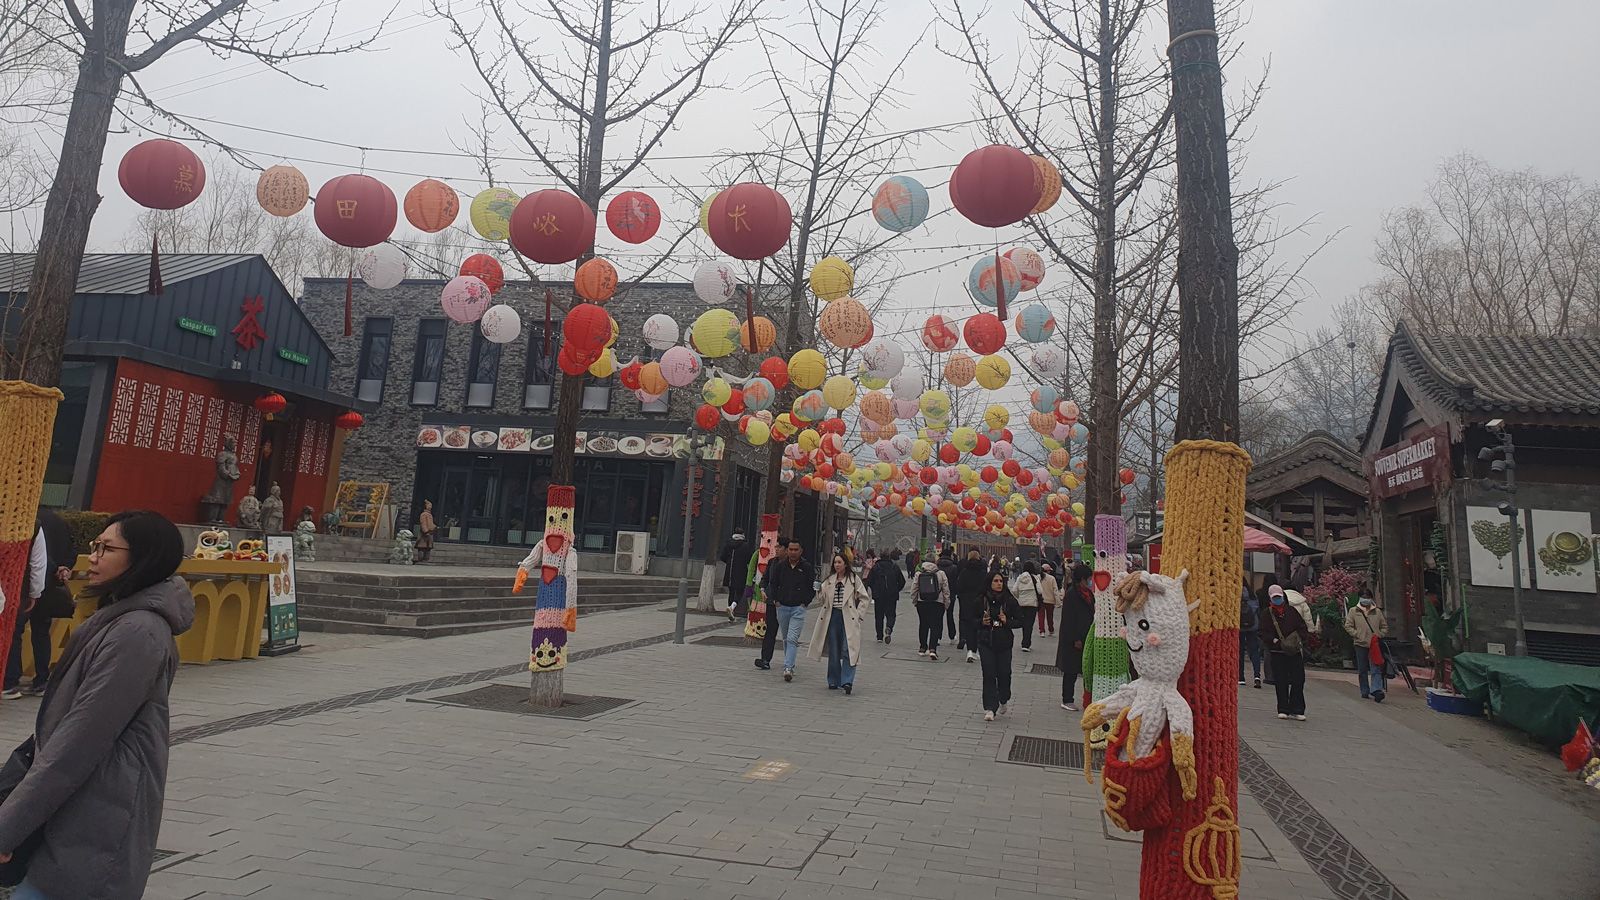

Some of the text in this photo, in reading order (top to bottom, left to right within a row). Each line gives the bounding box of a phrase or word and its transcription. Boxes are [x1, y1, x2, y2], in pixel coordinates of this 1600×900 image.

[336, 199, 358, 219] 田
[727, 204, 752, 233] 长
[532, 211, 563, 236] 峪
[204, 324, 217, 336] King
[232, 295, 269, 351] 茶
[281, 349, 309, 365] Tea House
[1375, 437, 1435, 476] SOUVENIR SUPERMARKET
